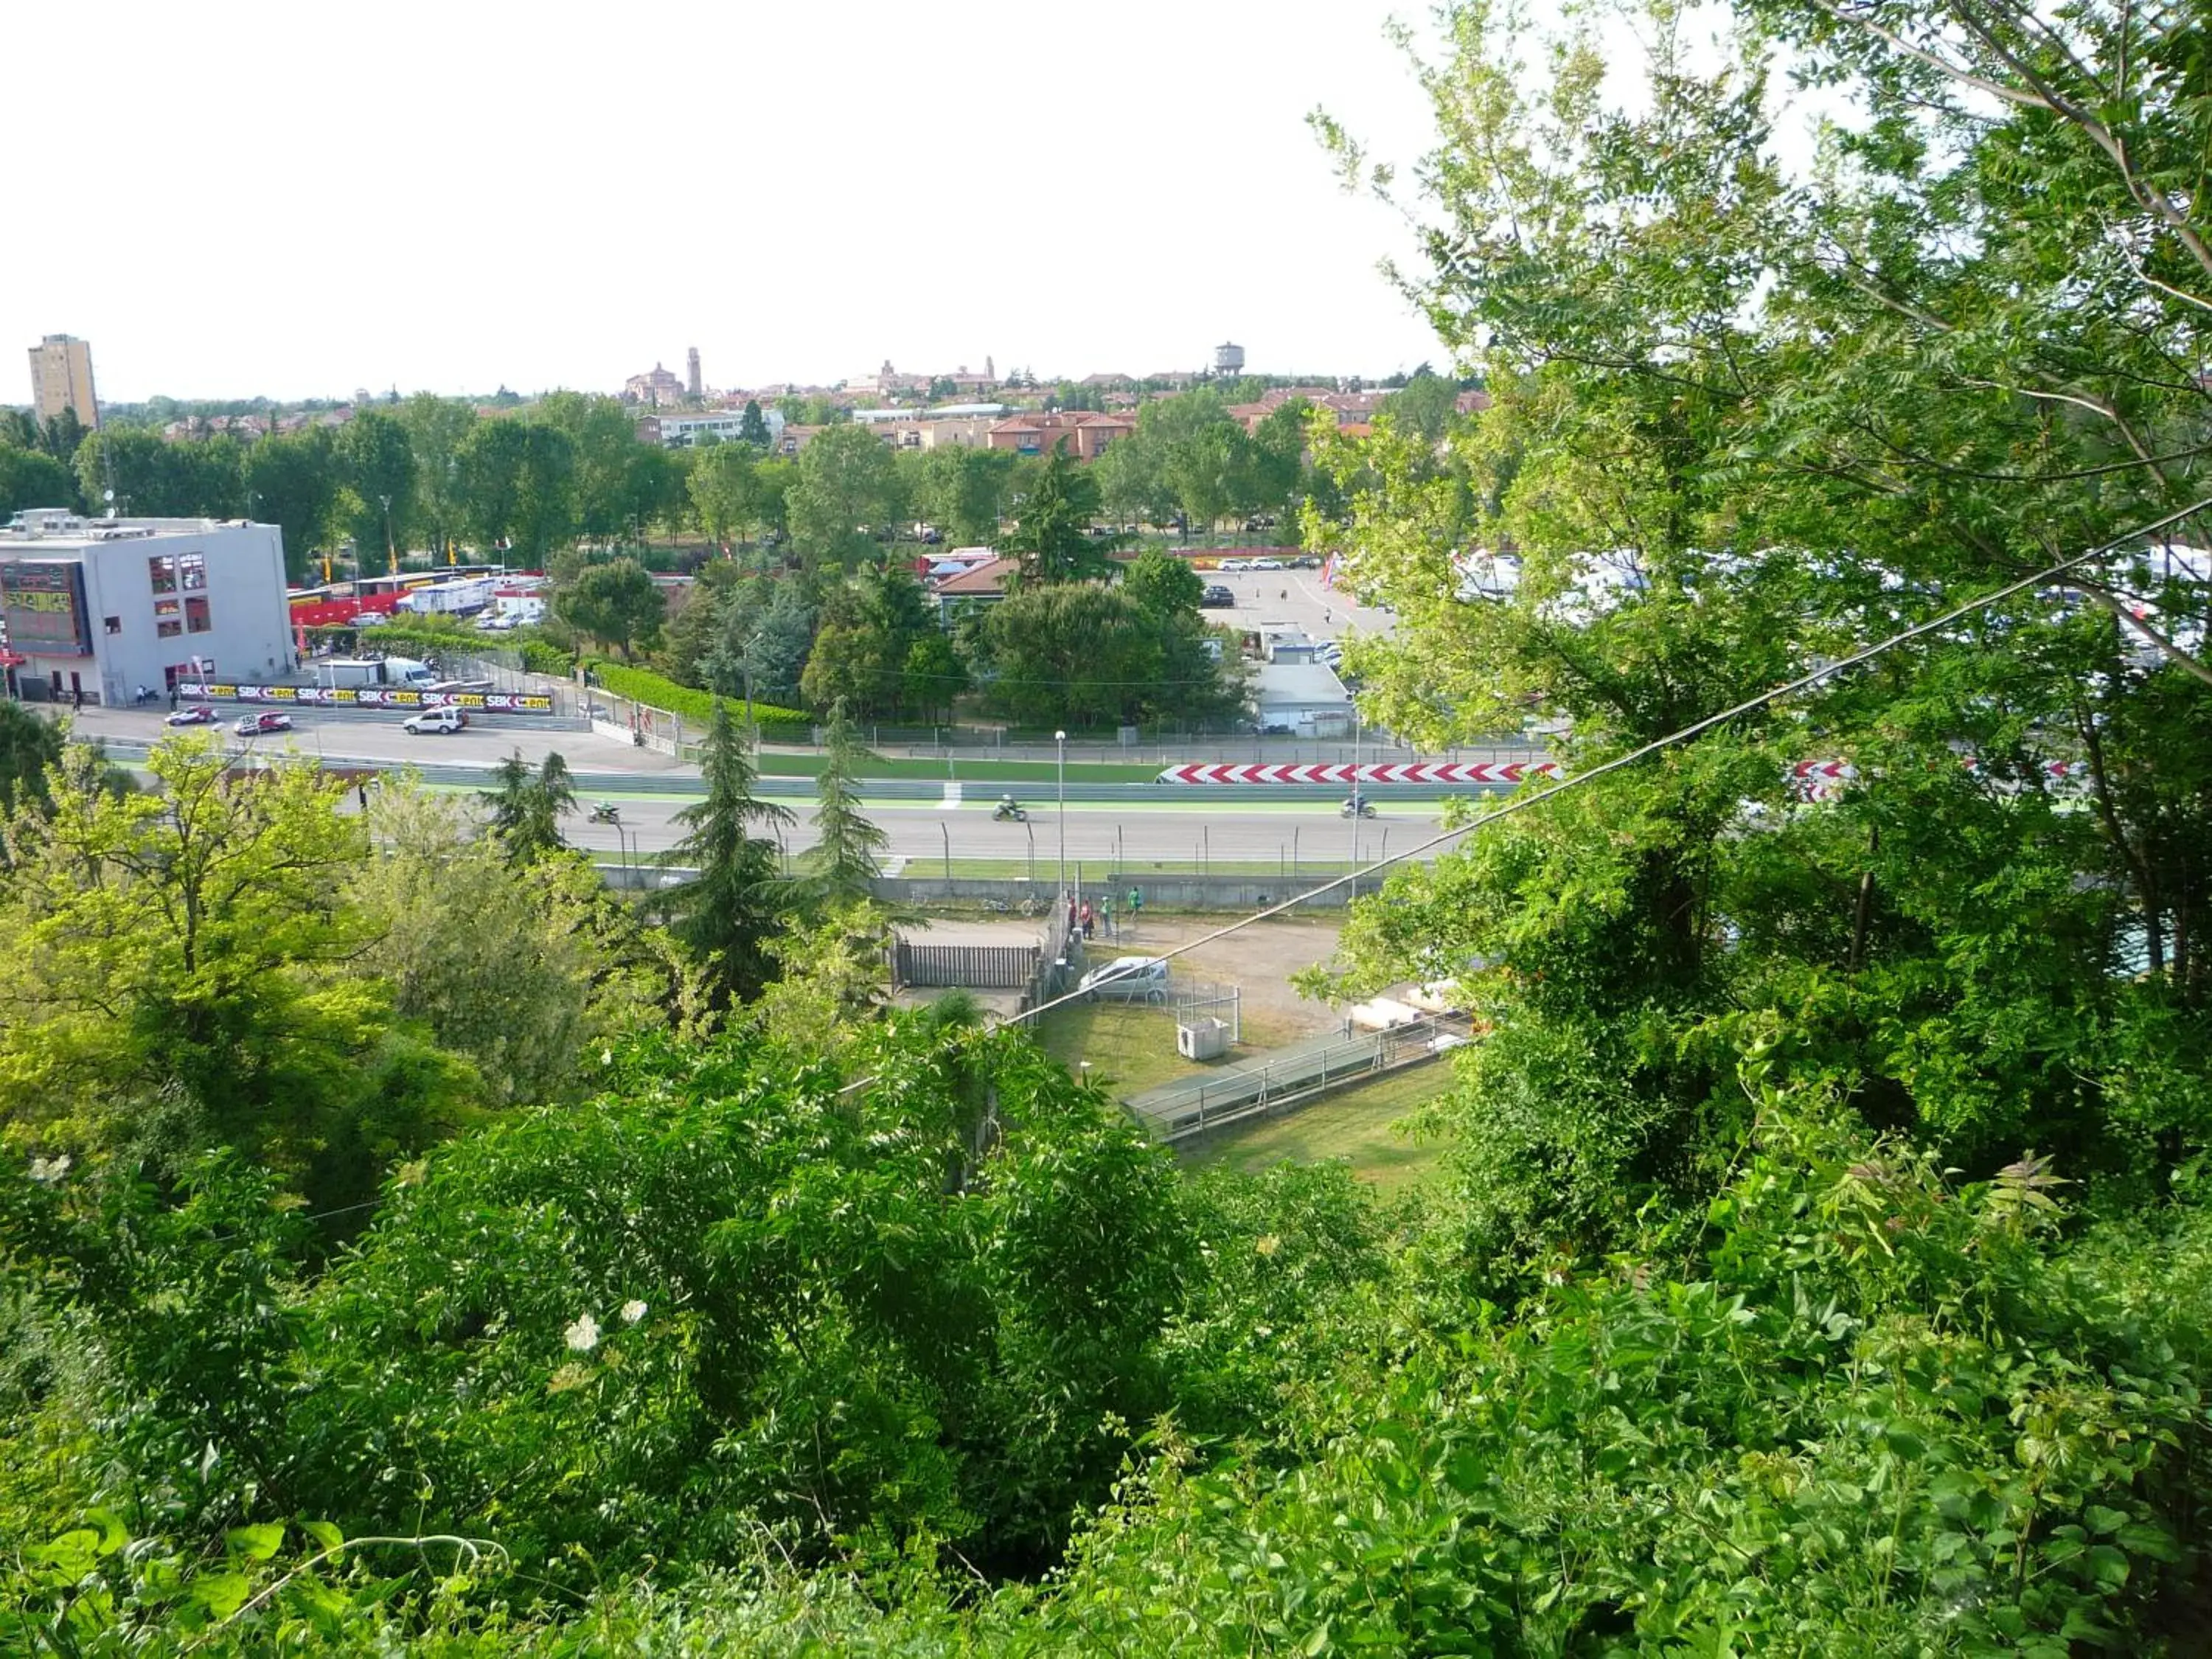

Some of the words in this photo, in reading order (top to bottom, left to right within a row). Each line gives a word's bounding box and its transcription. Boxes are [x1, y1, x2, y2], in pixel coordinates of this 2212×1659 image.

[238, 686, 262, 698] SBK
[298, 688, 322, 699] SBK
[359, 691, 383, 701] SBK
[422, 692, 447, 704] SBK
[487, 695, 512, 707] SBK
